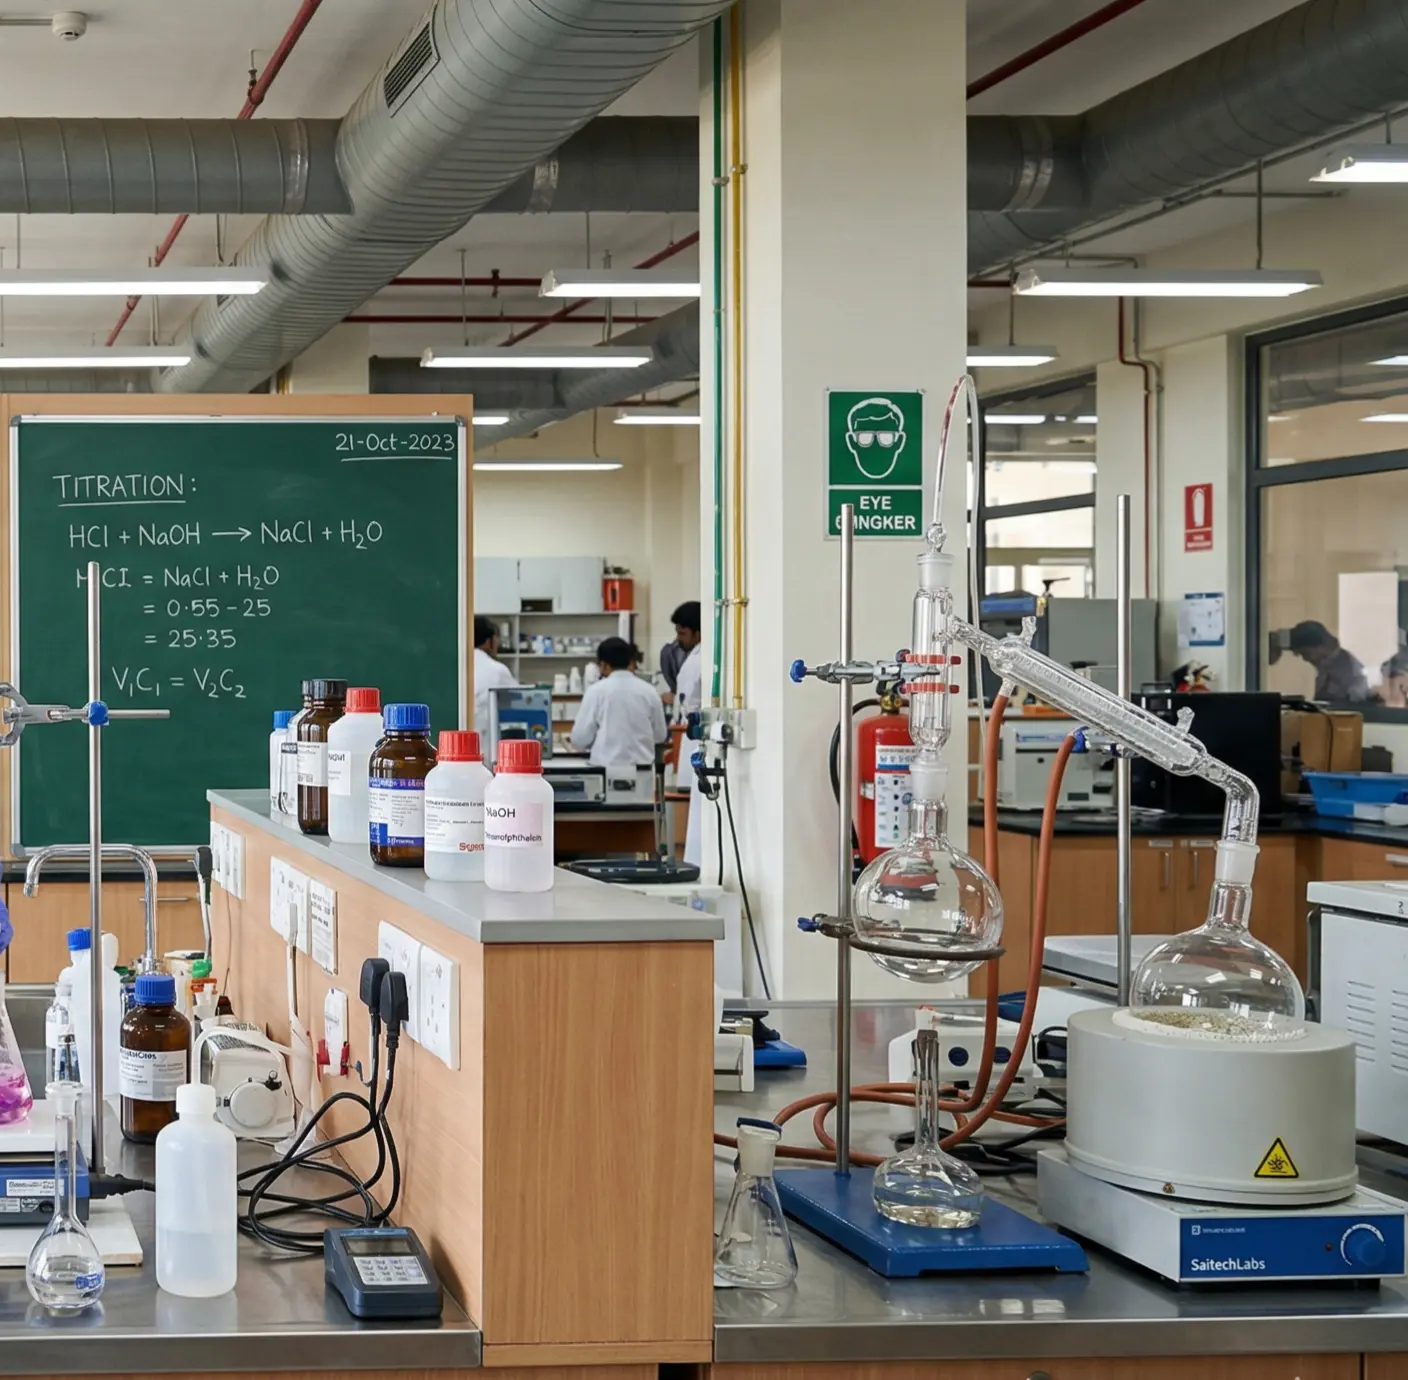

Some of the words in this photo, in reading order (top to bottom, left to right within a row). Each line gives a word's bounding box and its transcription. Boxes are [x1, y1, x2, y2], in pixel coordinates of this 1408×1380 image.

[335, 432, 455, 452] 21-Oct-2023
[860, 495, 891, 510] EYE
[119, 530, 131, 544] +
[138, 522, 200, 546] NaOH
[260, 519, 312, 544] NaCl
[322, 526, 332, 541] +
[142, 574, 153, 584] =
[164, 566, 210, 588] NaCl
[219, 571, 229, 584] +
[143, 604, 155, 614] =
[243, 598, 271, 617] 25
[144, 634, 157, 644] =
[169, 676, 185, 687] =
[1191, 1257, 1266, 1271] SaitechLabs
